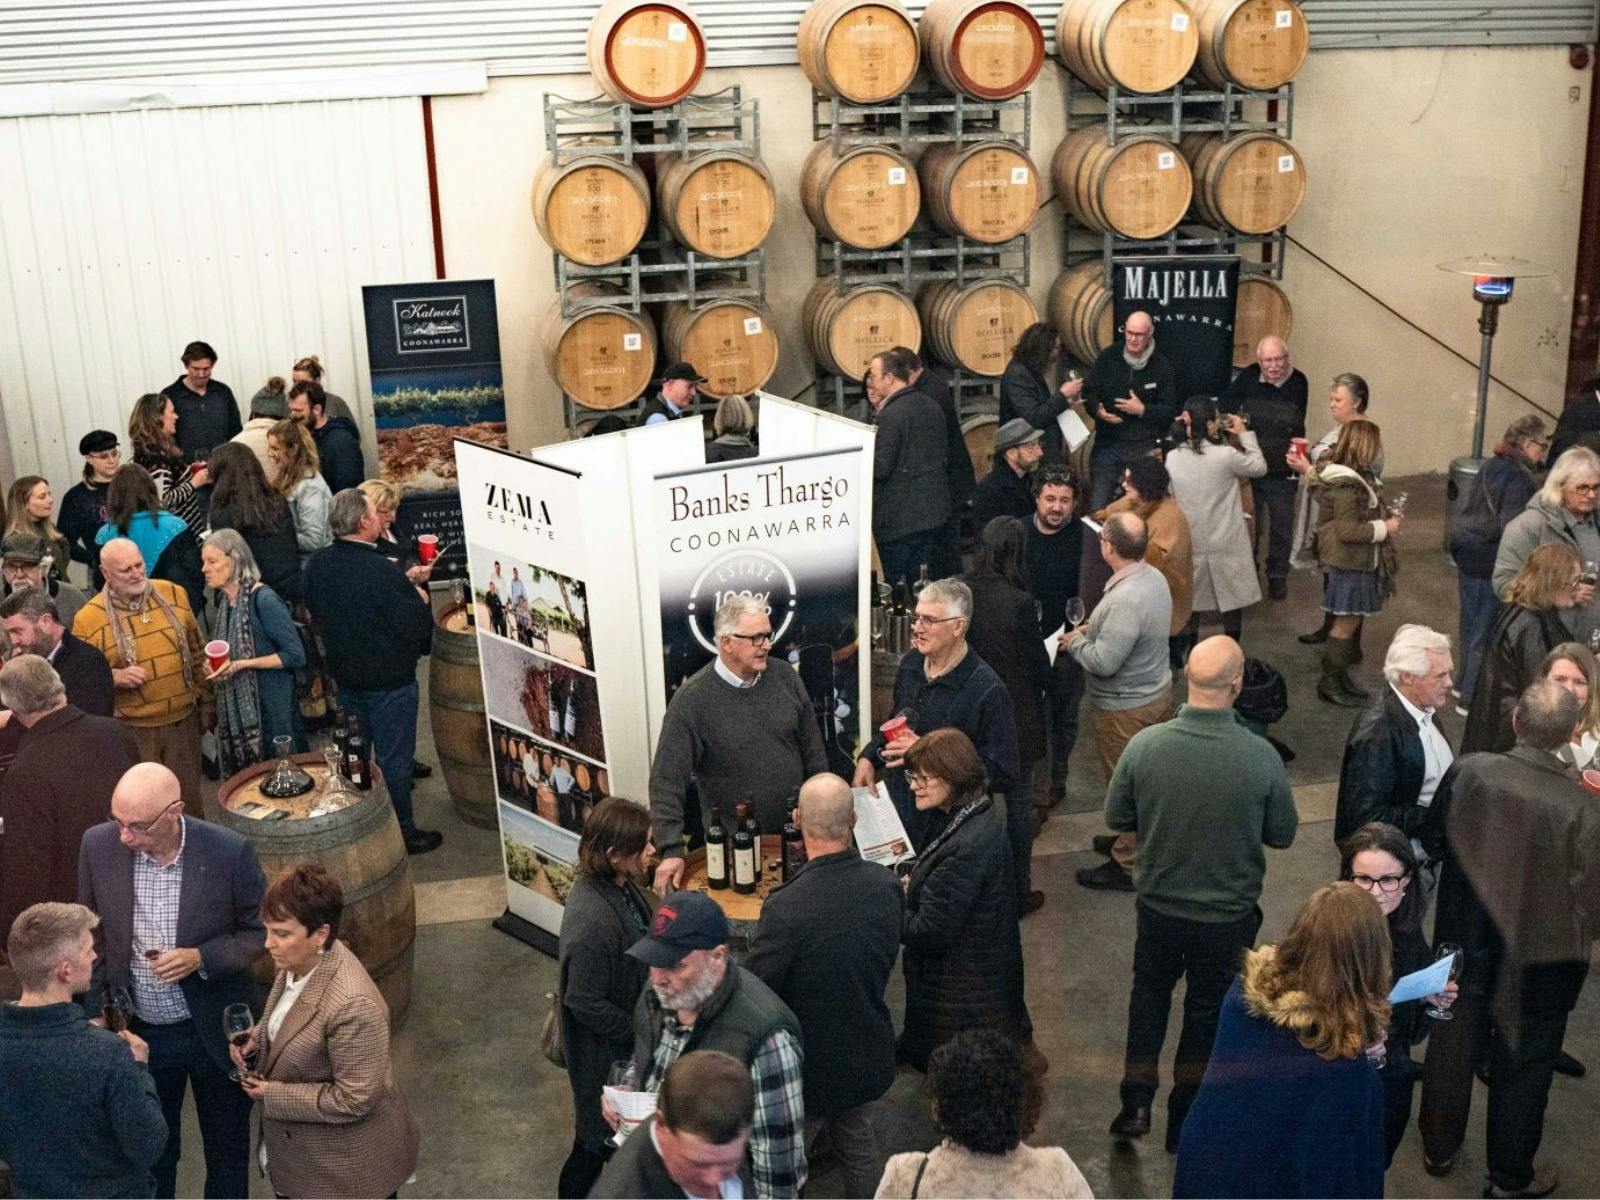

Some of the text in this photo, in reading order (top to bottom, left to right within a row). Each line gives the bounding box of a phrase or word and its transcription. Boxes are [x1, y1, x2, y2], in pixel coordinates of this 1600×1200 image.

[1124, 266, 1228, 306] MAJELLA
[400, 303, 461, 319] Katnook
[1118, 312, 1233, 333] CNAWARRA
[403, 337, 464, 347] COONAWARRA
[485, 482, 552, 526] ZEMA
[669, 465, 849, 522] Banks Thargo
[487, 511, 555, 541] ESTATE
[670, 512, 850, 553] COONAWARRA
[716, 559, 778, 583] ESTATE
